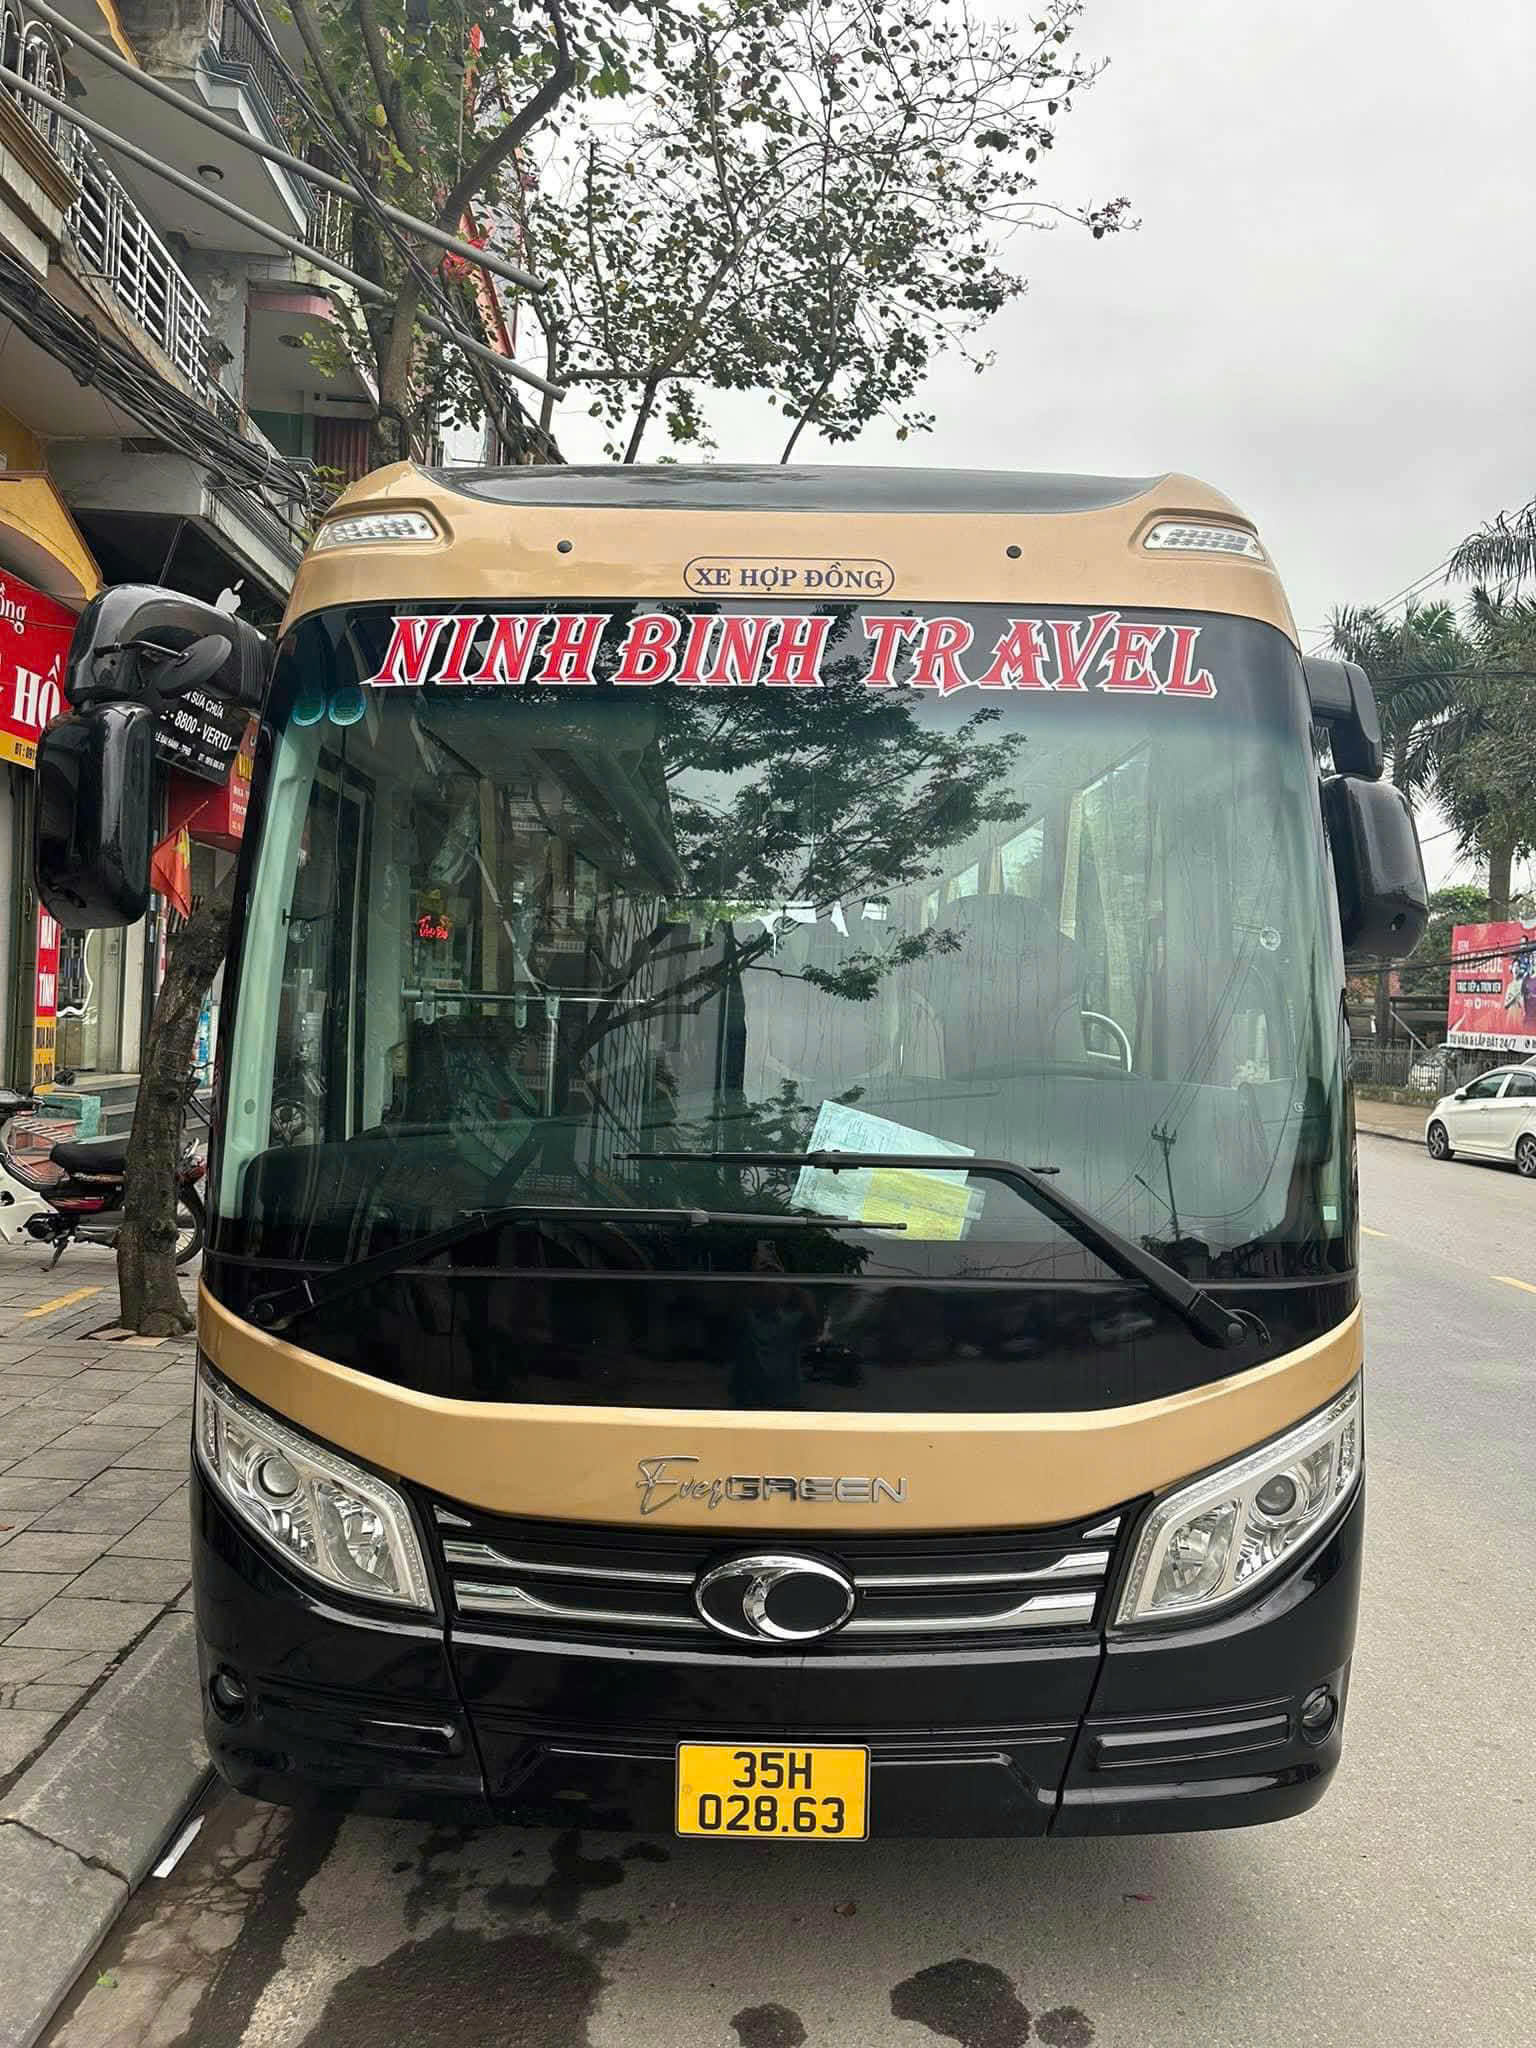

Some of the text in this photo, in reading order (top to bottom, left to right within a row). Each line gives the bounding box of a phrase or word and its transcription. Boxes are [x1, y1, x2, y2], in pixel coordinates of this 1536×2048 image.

[695, 561, 884, 592] XE HỢP ĐỒNG
[359, 611, 1218, 699] NINH BINH TRAVEL
[174, 710, 198, 734] 8800
[202, 723, 232, 751] VERTU
[1500, 1038, 1516, 1050] 24/7
[732, 1751, 813, 1790] 35H
[698, 1793, 845, 1834] 028.63
